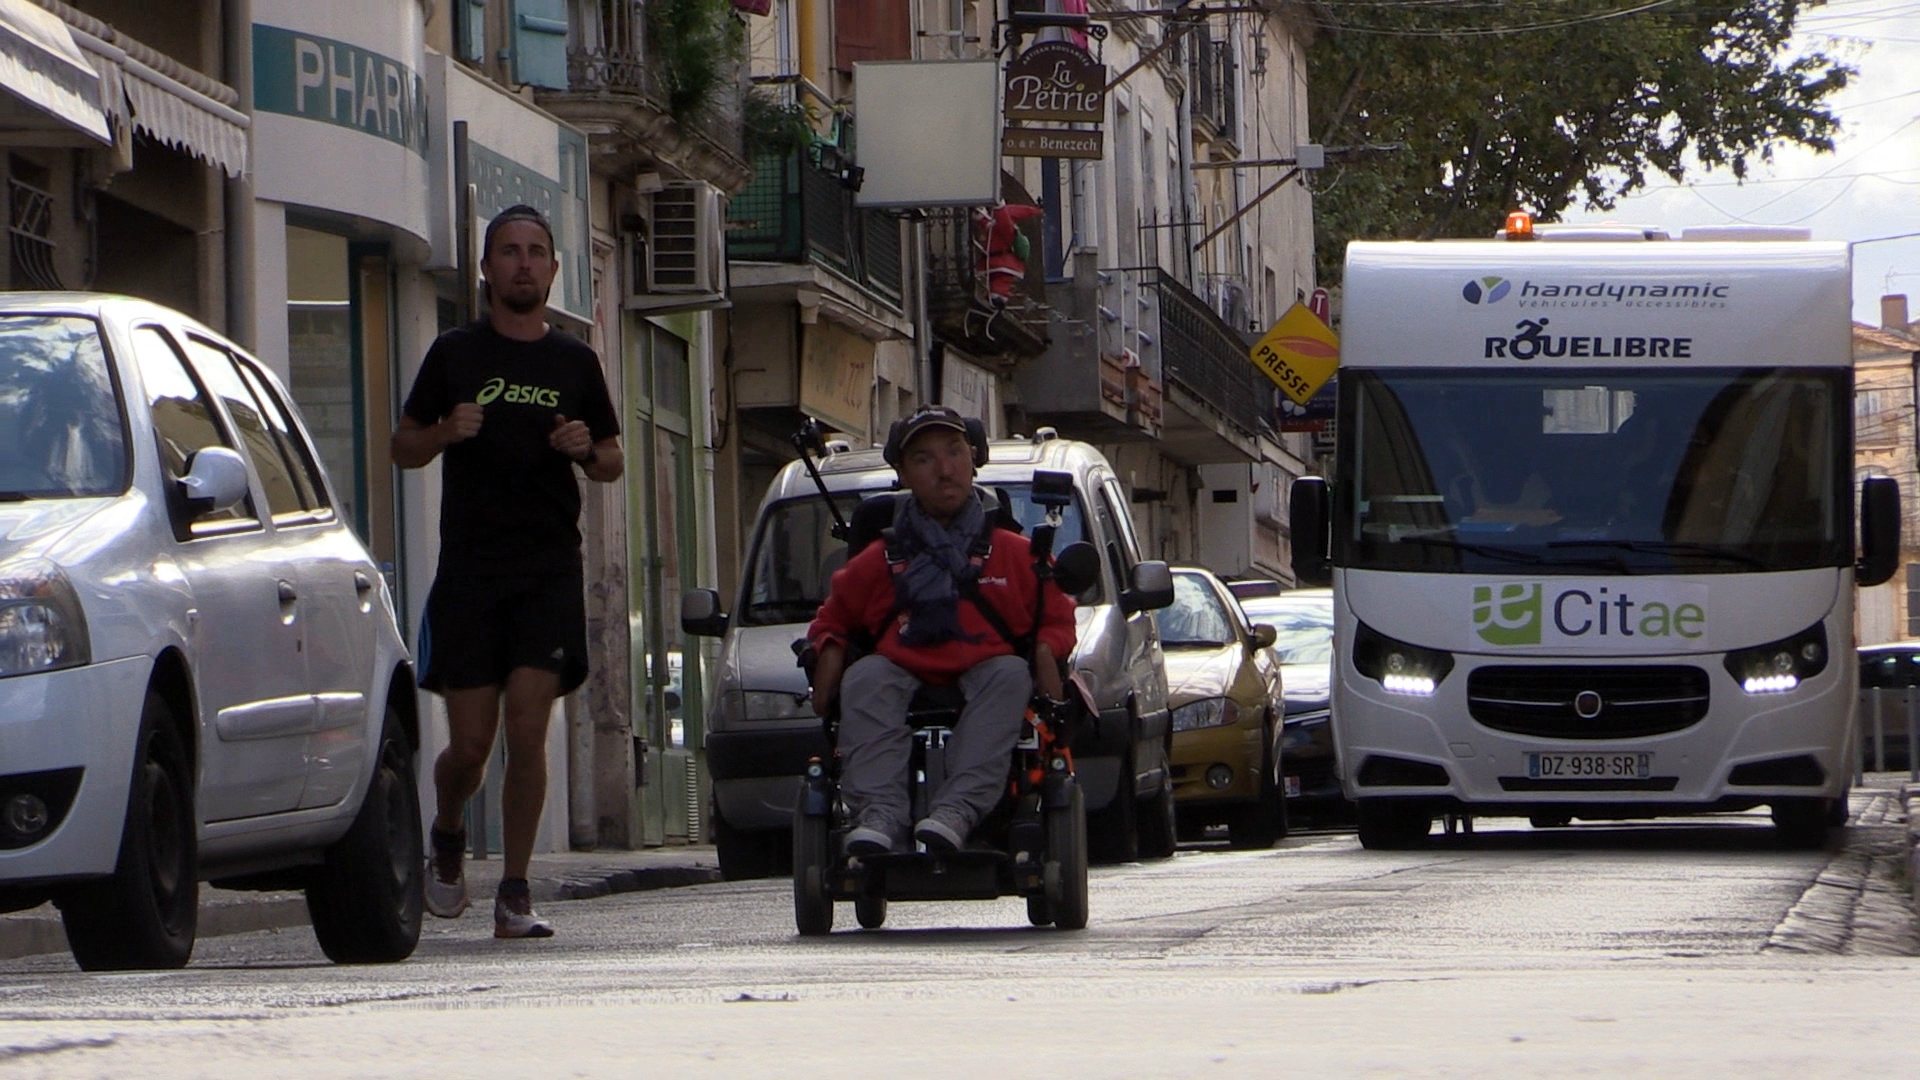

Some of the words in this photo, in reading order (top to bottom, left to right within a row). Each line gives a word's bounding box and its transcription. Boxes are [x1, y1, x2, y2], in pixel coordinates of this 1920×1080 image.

[1048, 60, 1077, 88] La
[1040, 136, 1097, 151] Benezech
[1520, 281, 1730, 301] handynamic
[1626, 300, 1726, 309] accessibles
[1484, 336, 1692, 360] ROUELIBRE
[1257, 345, 1310, 397] PRESSE
[1554, 587, 1705, 639] Citae
